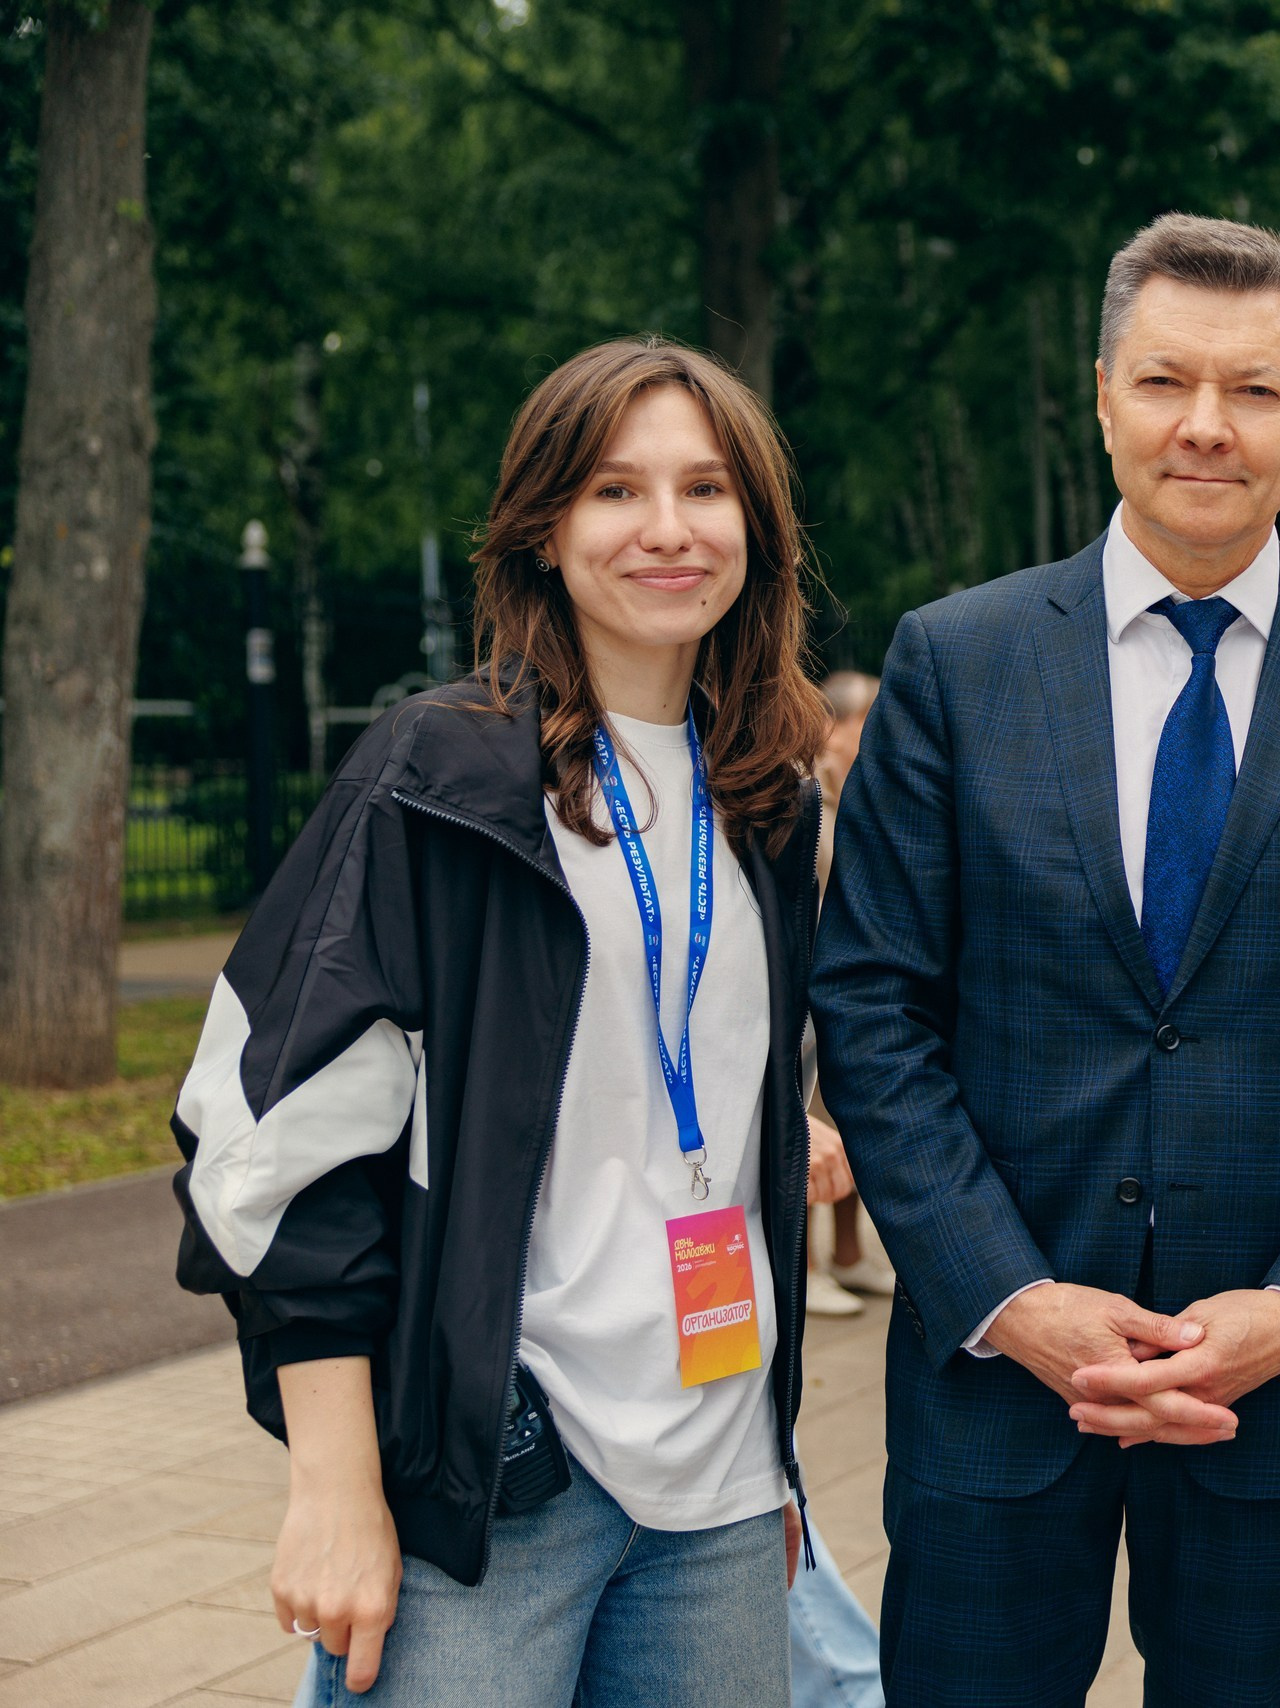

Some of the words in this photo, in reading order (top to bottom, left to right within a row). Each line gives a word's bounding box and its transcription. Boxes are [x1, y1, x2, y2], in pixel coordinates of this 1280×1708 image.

[614, 799, 632, 838] «ЕСТЬ
[628, 841, 656, 922] РЕЗУЛЬТАТ»
[698, 806, 708, 880] РЕЗУЛЬТАТ»
[697, 882, 708, 921] «ЕСТЬ
[677, 1263, 692, 1272] 2026
[684, 1303, 750, 1333] ОРГАНИЗАТОР
